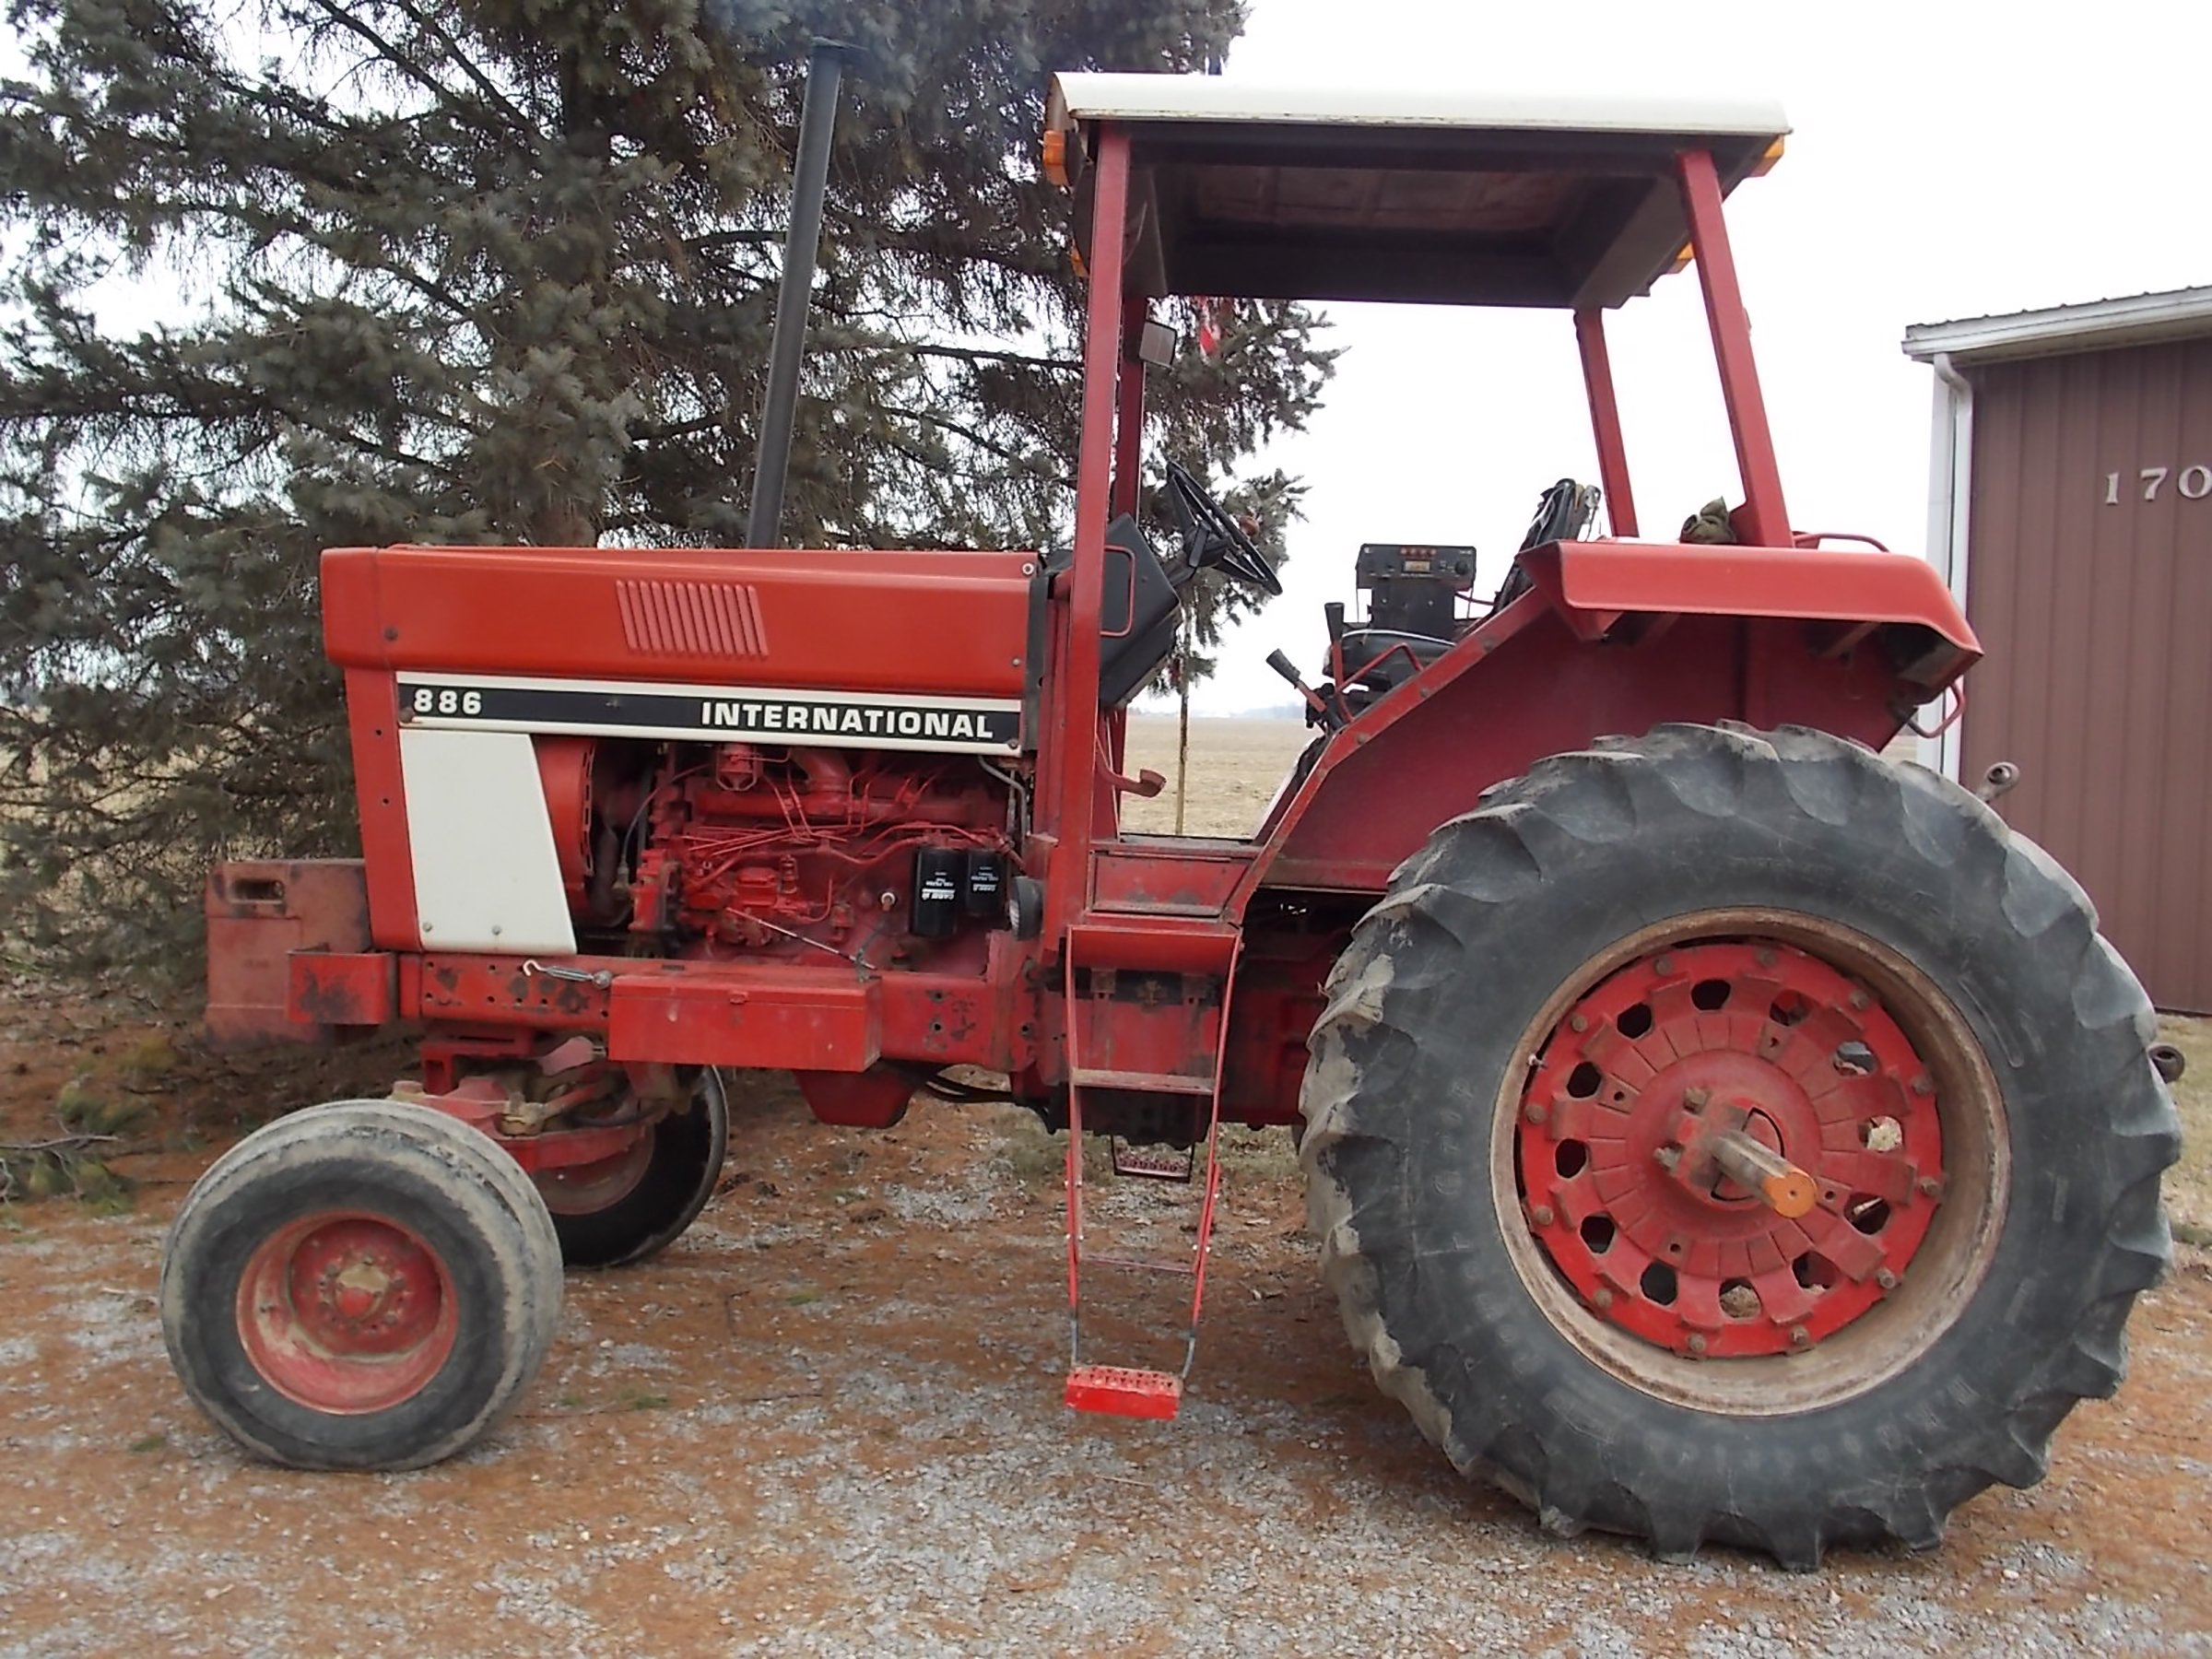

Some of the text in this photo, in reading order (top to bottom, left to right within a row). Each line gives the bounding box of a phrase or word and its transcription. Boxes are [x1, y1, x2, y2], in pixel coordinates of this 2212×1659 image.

[2104, 465, 2212, 506] 170
[414, 688, 994, 738] 886 INTERNATIONAL
